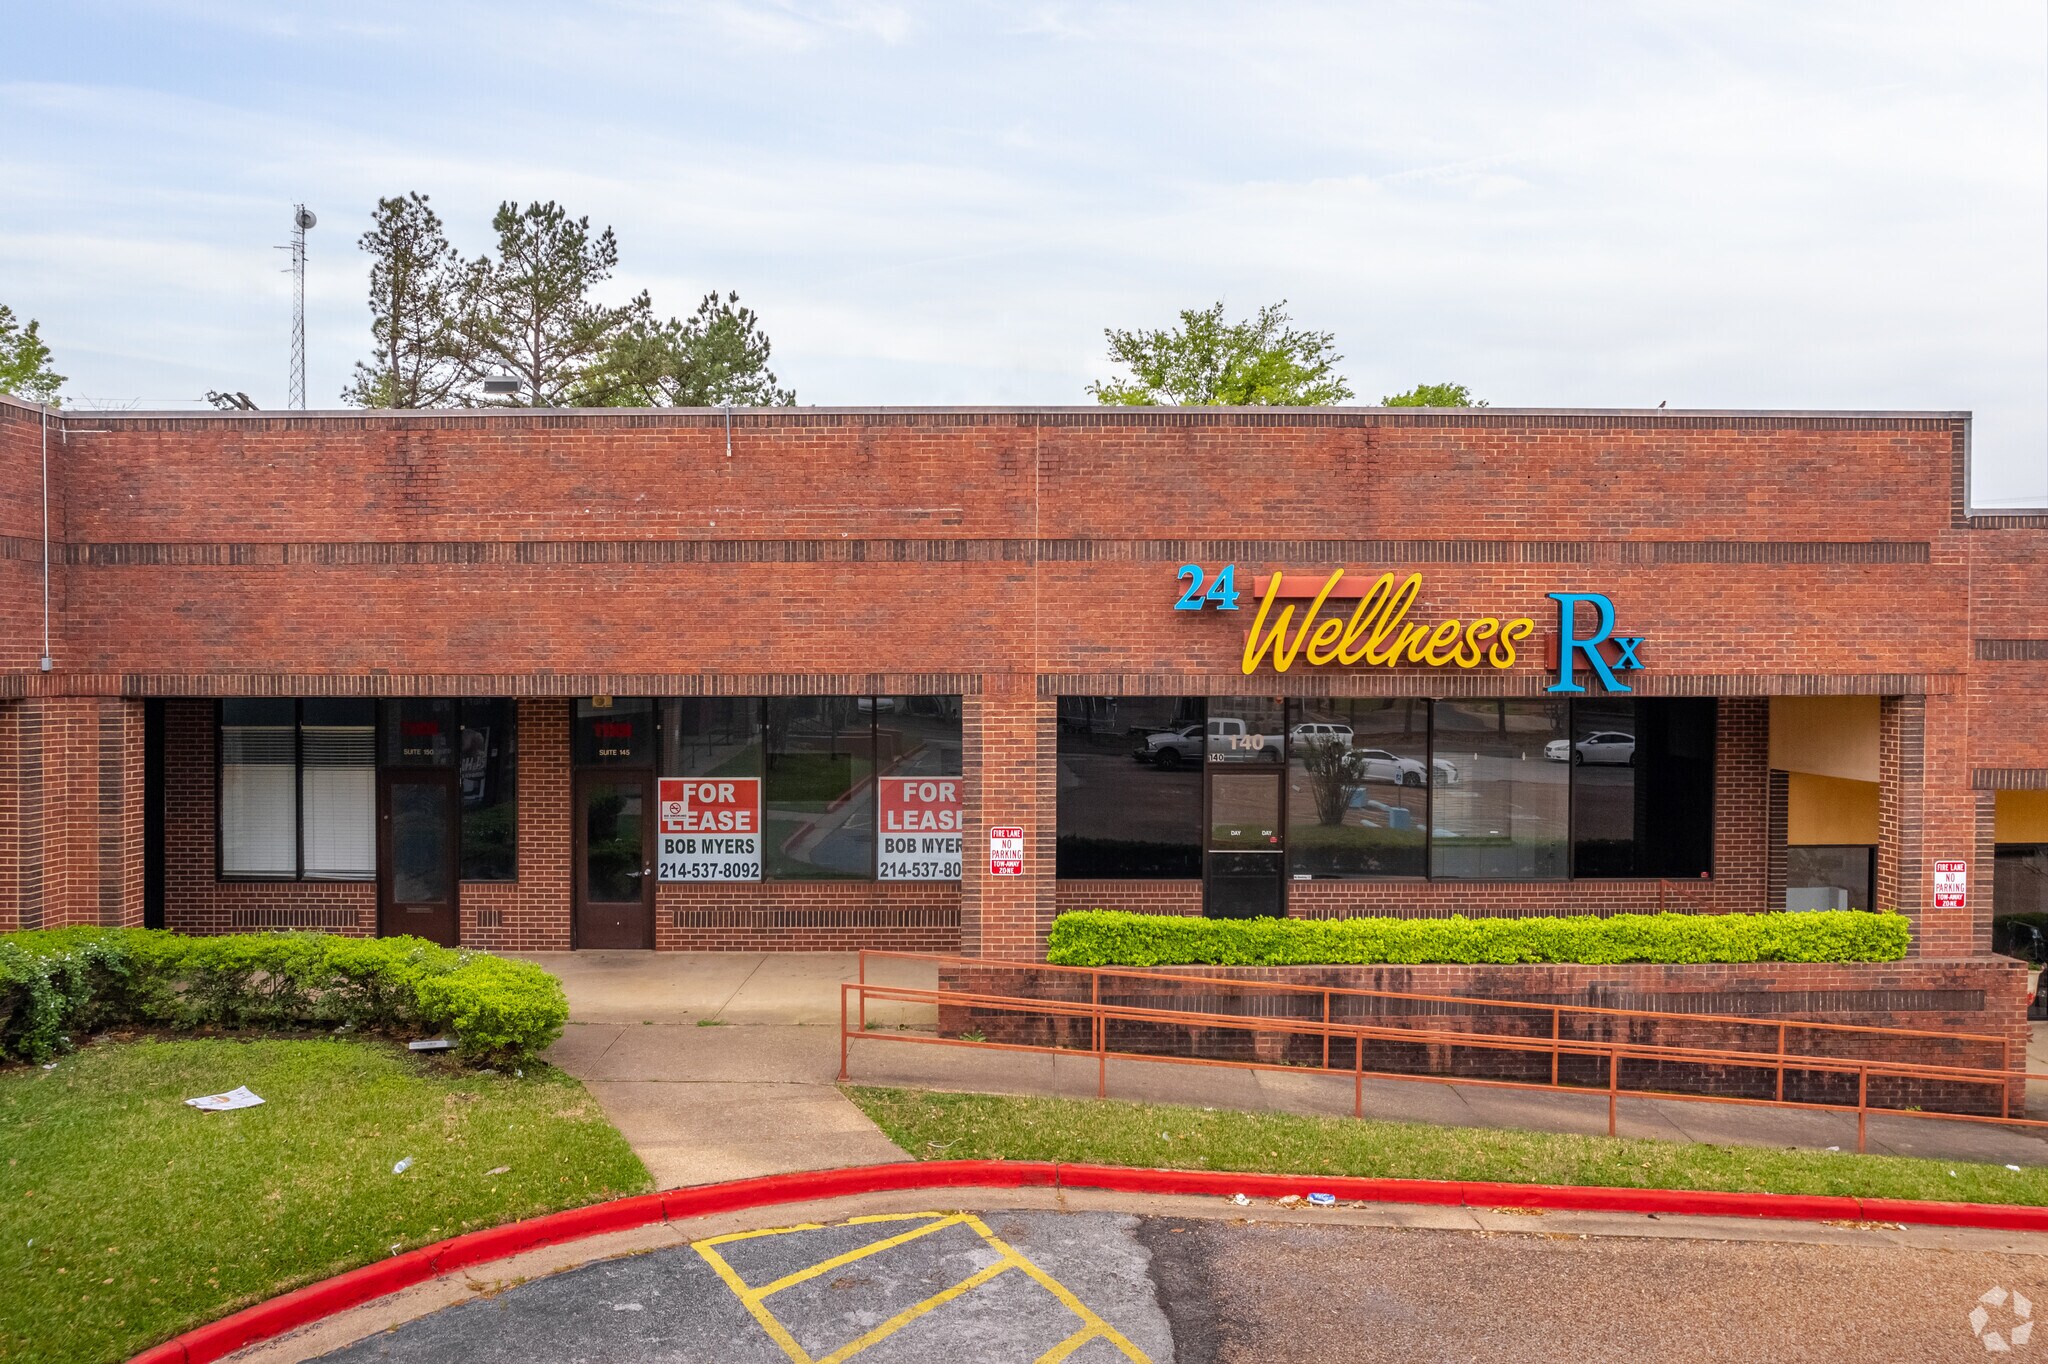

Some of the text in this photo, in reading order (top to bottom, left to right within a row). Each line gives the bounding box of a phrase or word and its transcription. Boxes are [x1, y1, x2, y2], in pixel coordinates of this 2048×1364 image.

[1173, 564, 1240, 611] 24
[1241, 568, 1535, 676] Wellness
[1229, 733, 1265, 750] 140
[1209, 753, 1225, 762] 140
[683, 783, 736, 803] FOR
[903, 782, 956, 802] FOR
[665, 838, 755, 854] BOB MYERS
[885, 838, 962, 853] BOB MYER
[1001, 839, 1012, 849] NO
[992, 849, 1022, 860] PARKING
[660, 862, 760, 878] 214-537-8092
[880, 862, 962, 878] 214-537-80
[1945, 873, 1955, 882] NO
[1936, 883, 1964, 892] PARKING
